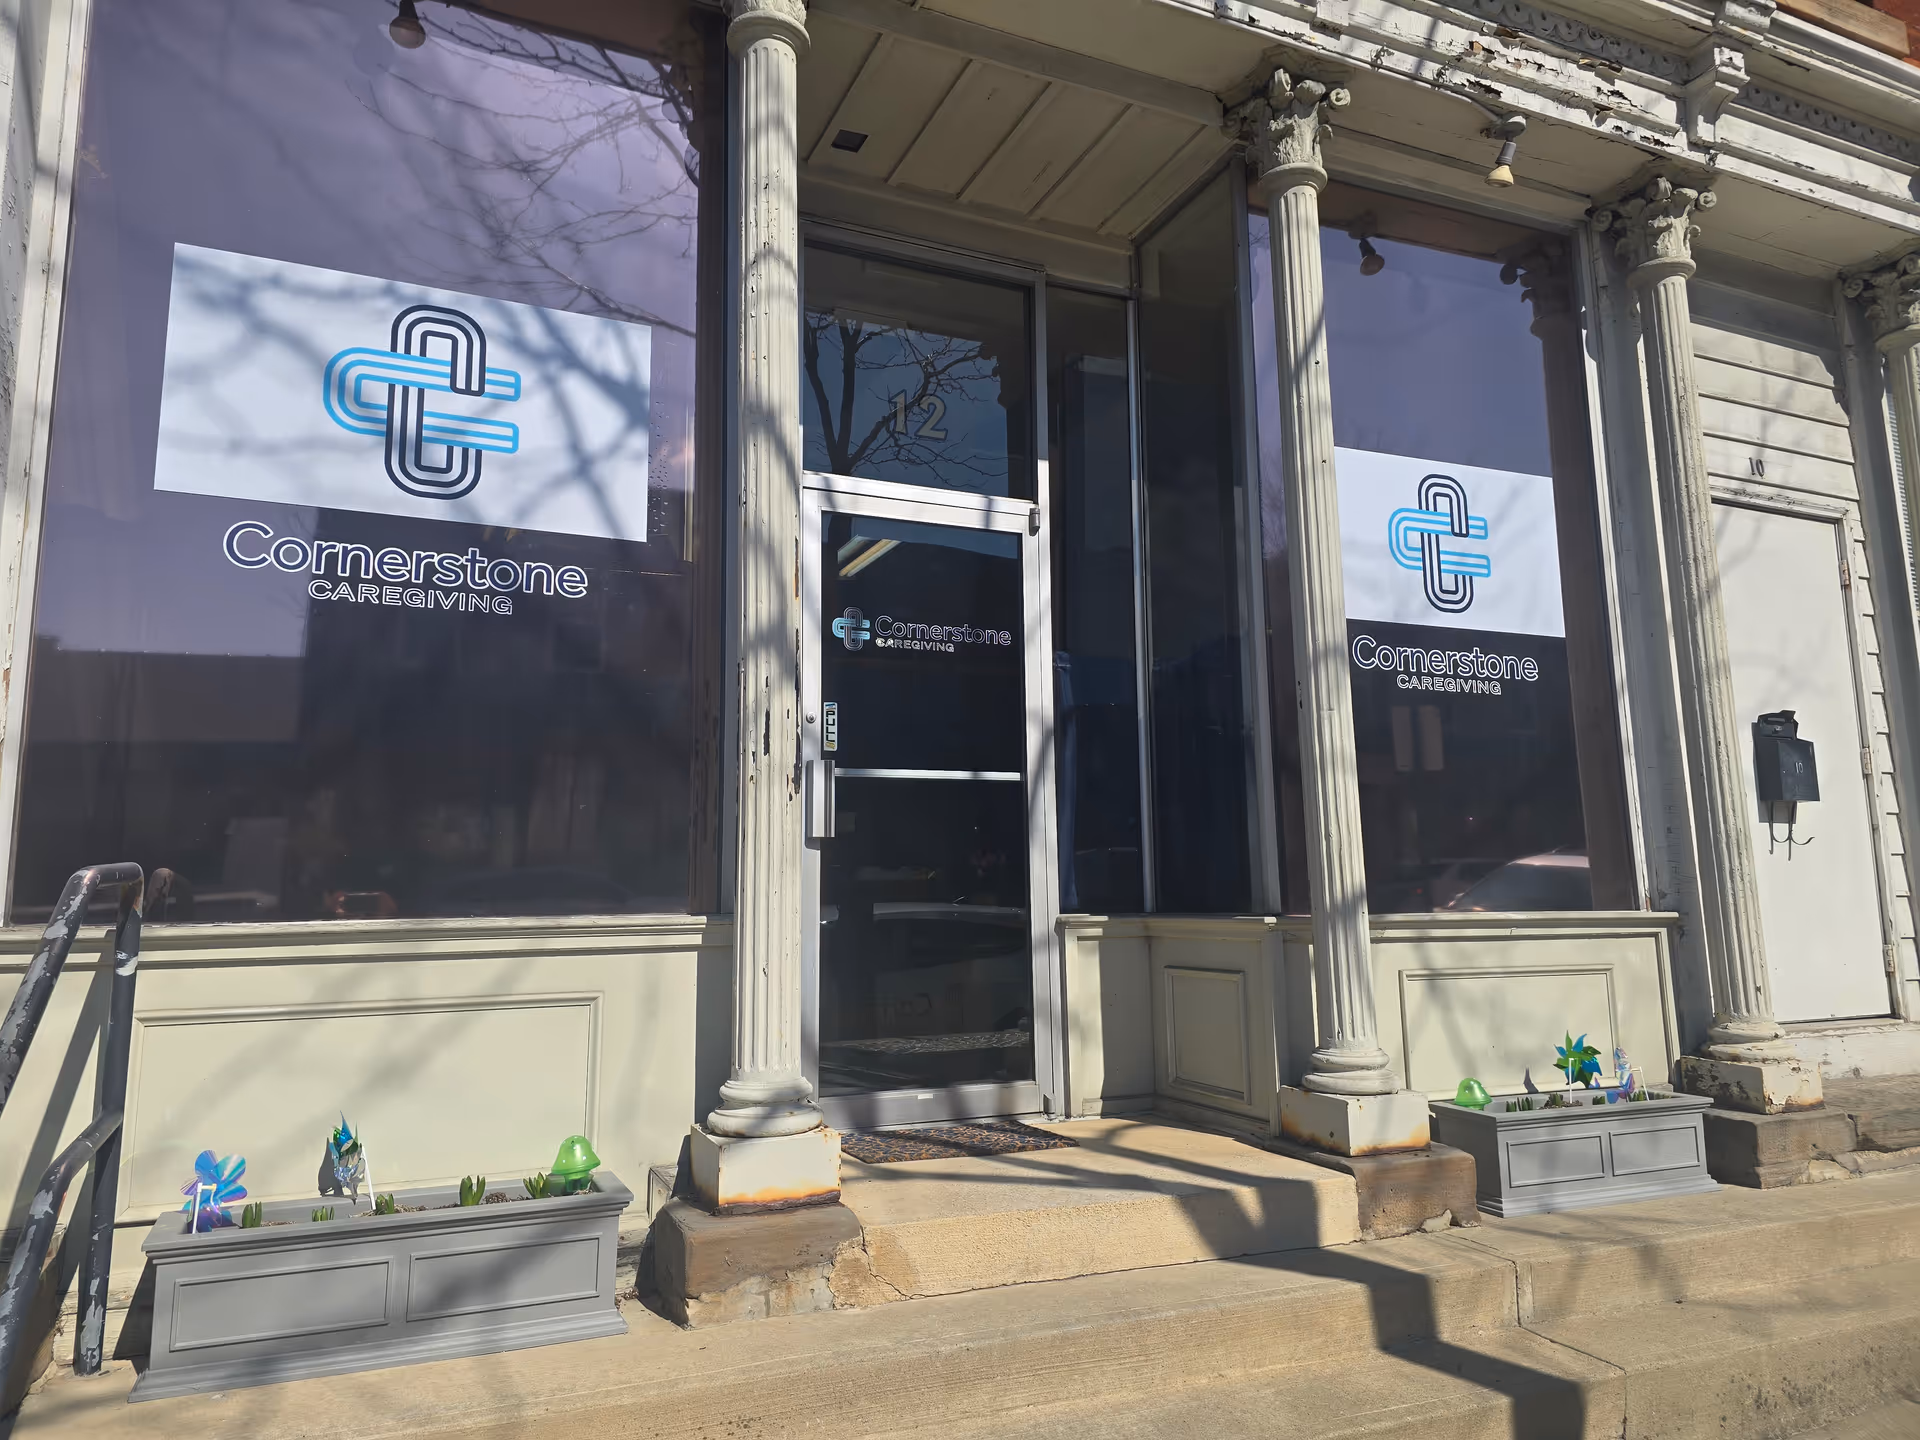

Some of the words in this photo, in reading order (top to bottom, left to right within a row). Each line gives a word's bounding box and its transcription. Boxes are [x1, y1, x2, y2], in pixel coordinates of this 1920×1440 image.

[888, 389, 948, 441] 12
[1748, 457, 1765, 477] 10
[223, 521, 588, 598] Cornerstone
[308, 579, 513, 615] CAREGIVING
[875, 615, 1012, 646] Cornerstone
[875, 637, 955, 652] CAREGIVING
[1352, 635, 1539, 681] Cornerstone
[1396, 674, 1502, 696] CAREGIVING
[825, 710, 836, 743] PULL
